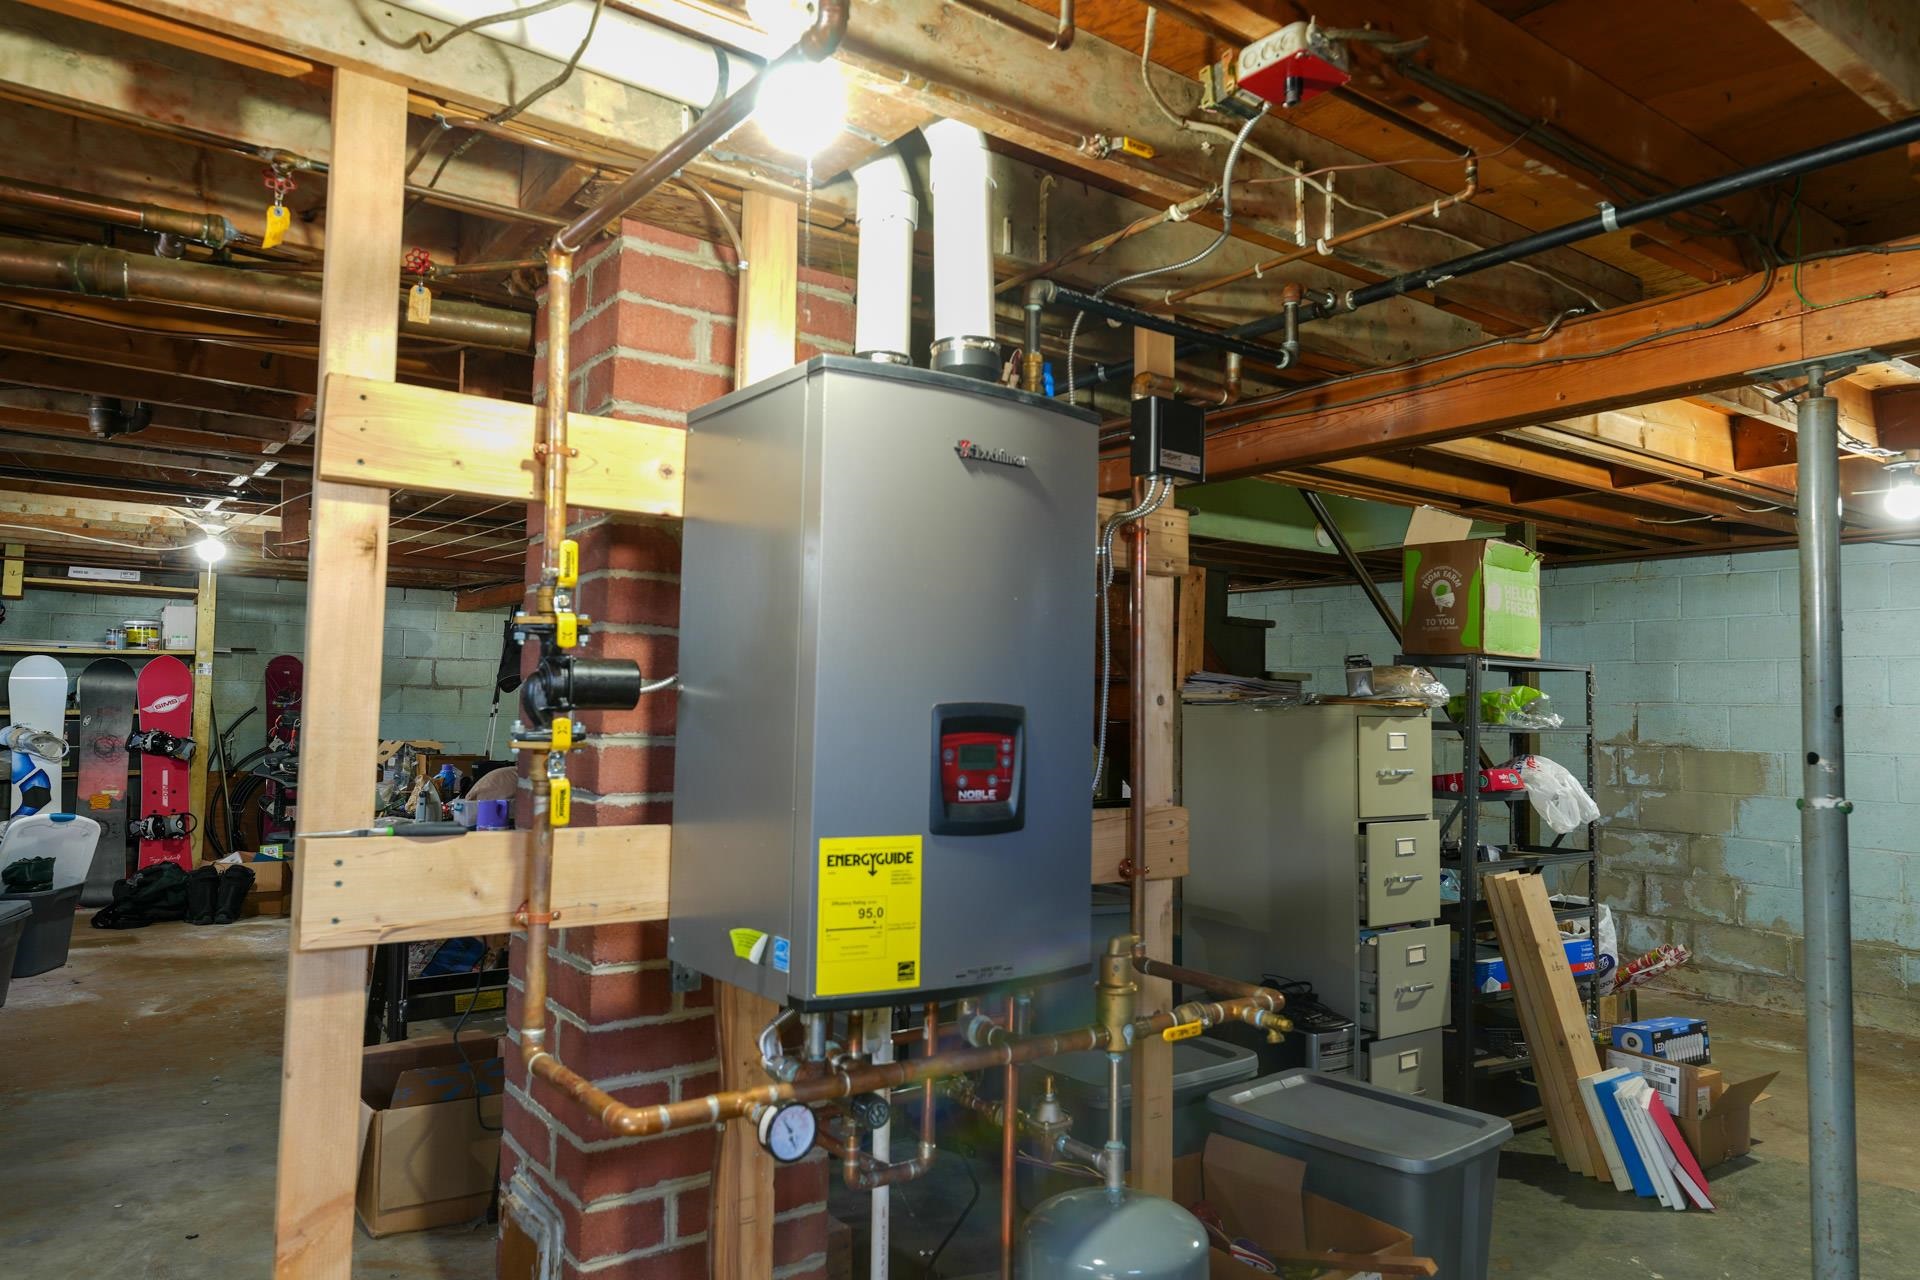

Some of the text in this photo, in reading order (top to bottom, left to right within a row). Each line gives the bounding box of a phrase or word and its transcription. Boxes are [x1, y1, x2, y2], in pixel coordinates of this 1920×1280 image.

[1422, 570, 1462, 589] FROM FARM
[1425, 617, 1455, 626] TO YOU
[154, 698, 178, 710] SIMS
[958, 789, 997, 801] NOBLE
[826, 851, 914, 867] ENERGYGUIDE
[858, 906, 884, 919] 95.0
[1584, 962, 1596, 971] 500
[1654, 1041, 1665, 1053] LED
